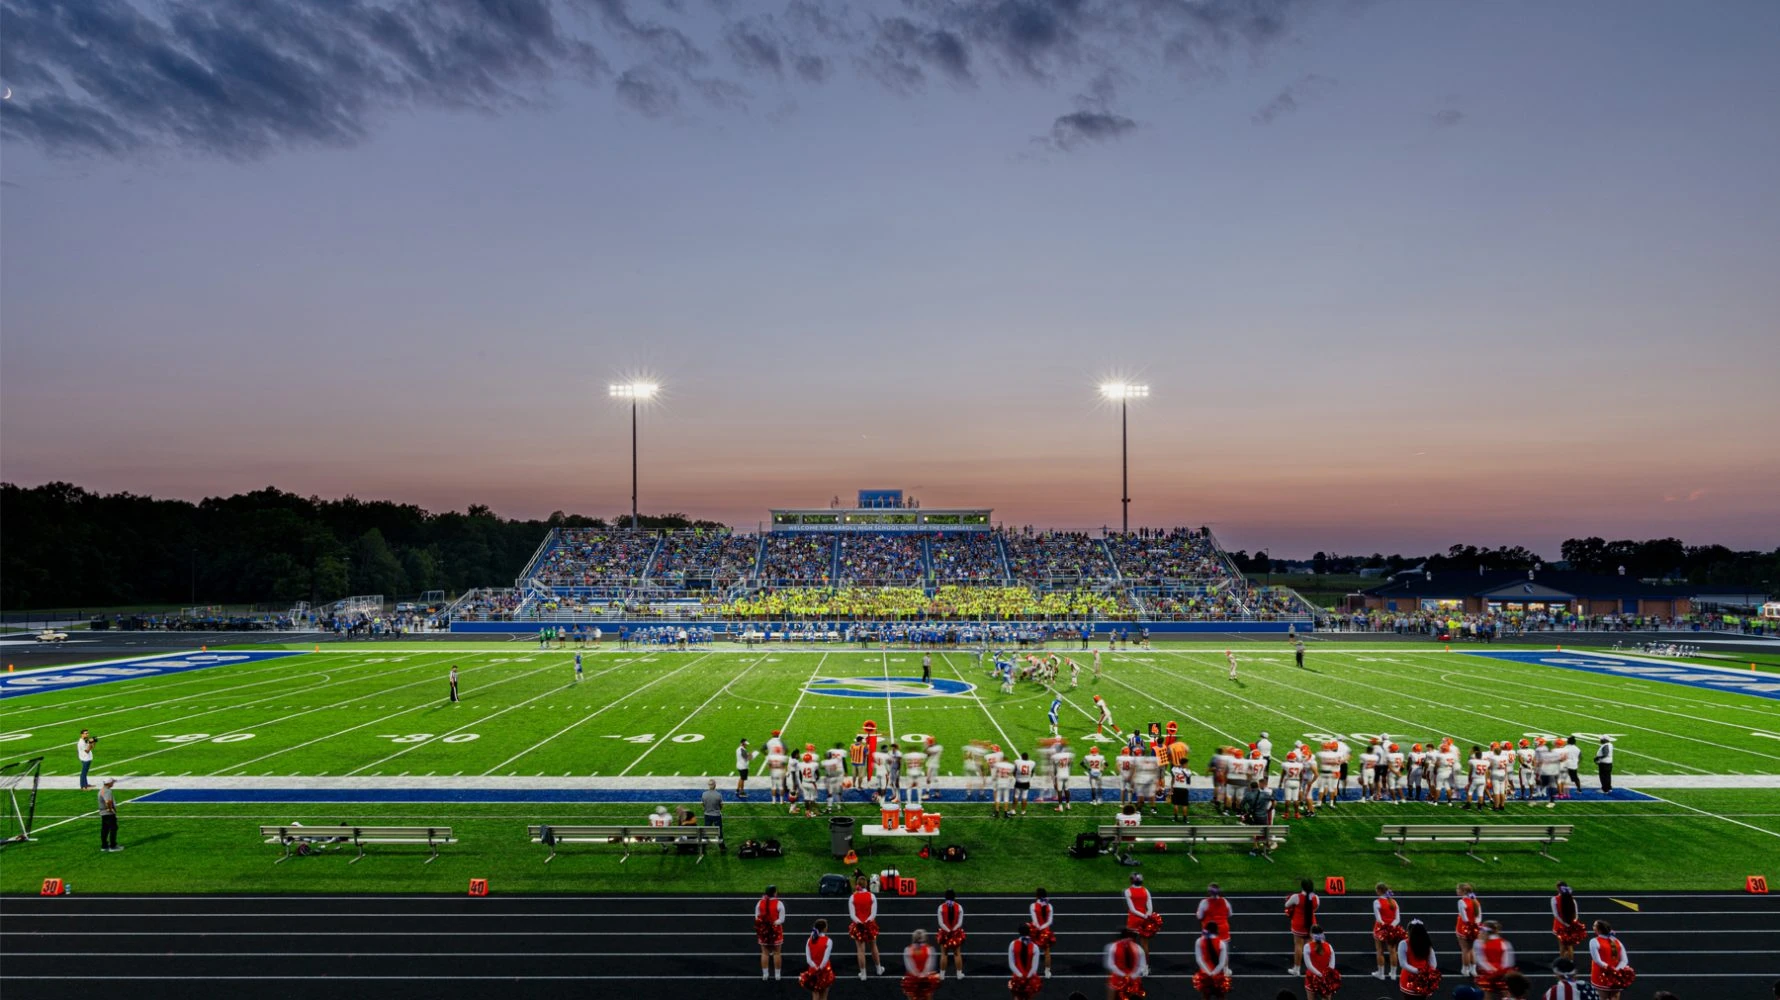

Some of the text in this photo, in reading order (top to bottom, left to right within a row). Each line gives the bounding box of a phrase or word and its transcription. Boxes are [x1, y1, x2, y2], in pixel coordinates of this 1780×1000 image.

[391, 733, 481, 743] 30
[623, 733, 705, 743] 40
[1090, 760, 1100, 769] 22
[1476, 764, 1487, 776] 55
[802, 768, 812, 778] 42
[1288, 768, 1300, 778] 57
[42, 880, 58, 892] 30
[470, 880, 484, 894] 40
[900, 880, 914, 893] 50
[1330, 879, 1343, 892] 40
[1750, 878, 1766, 891] 30
